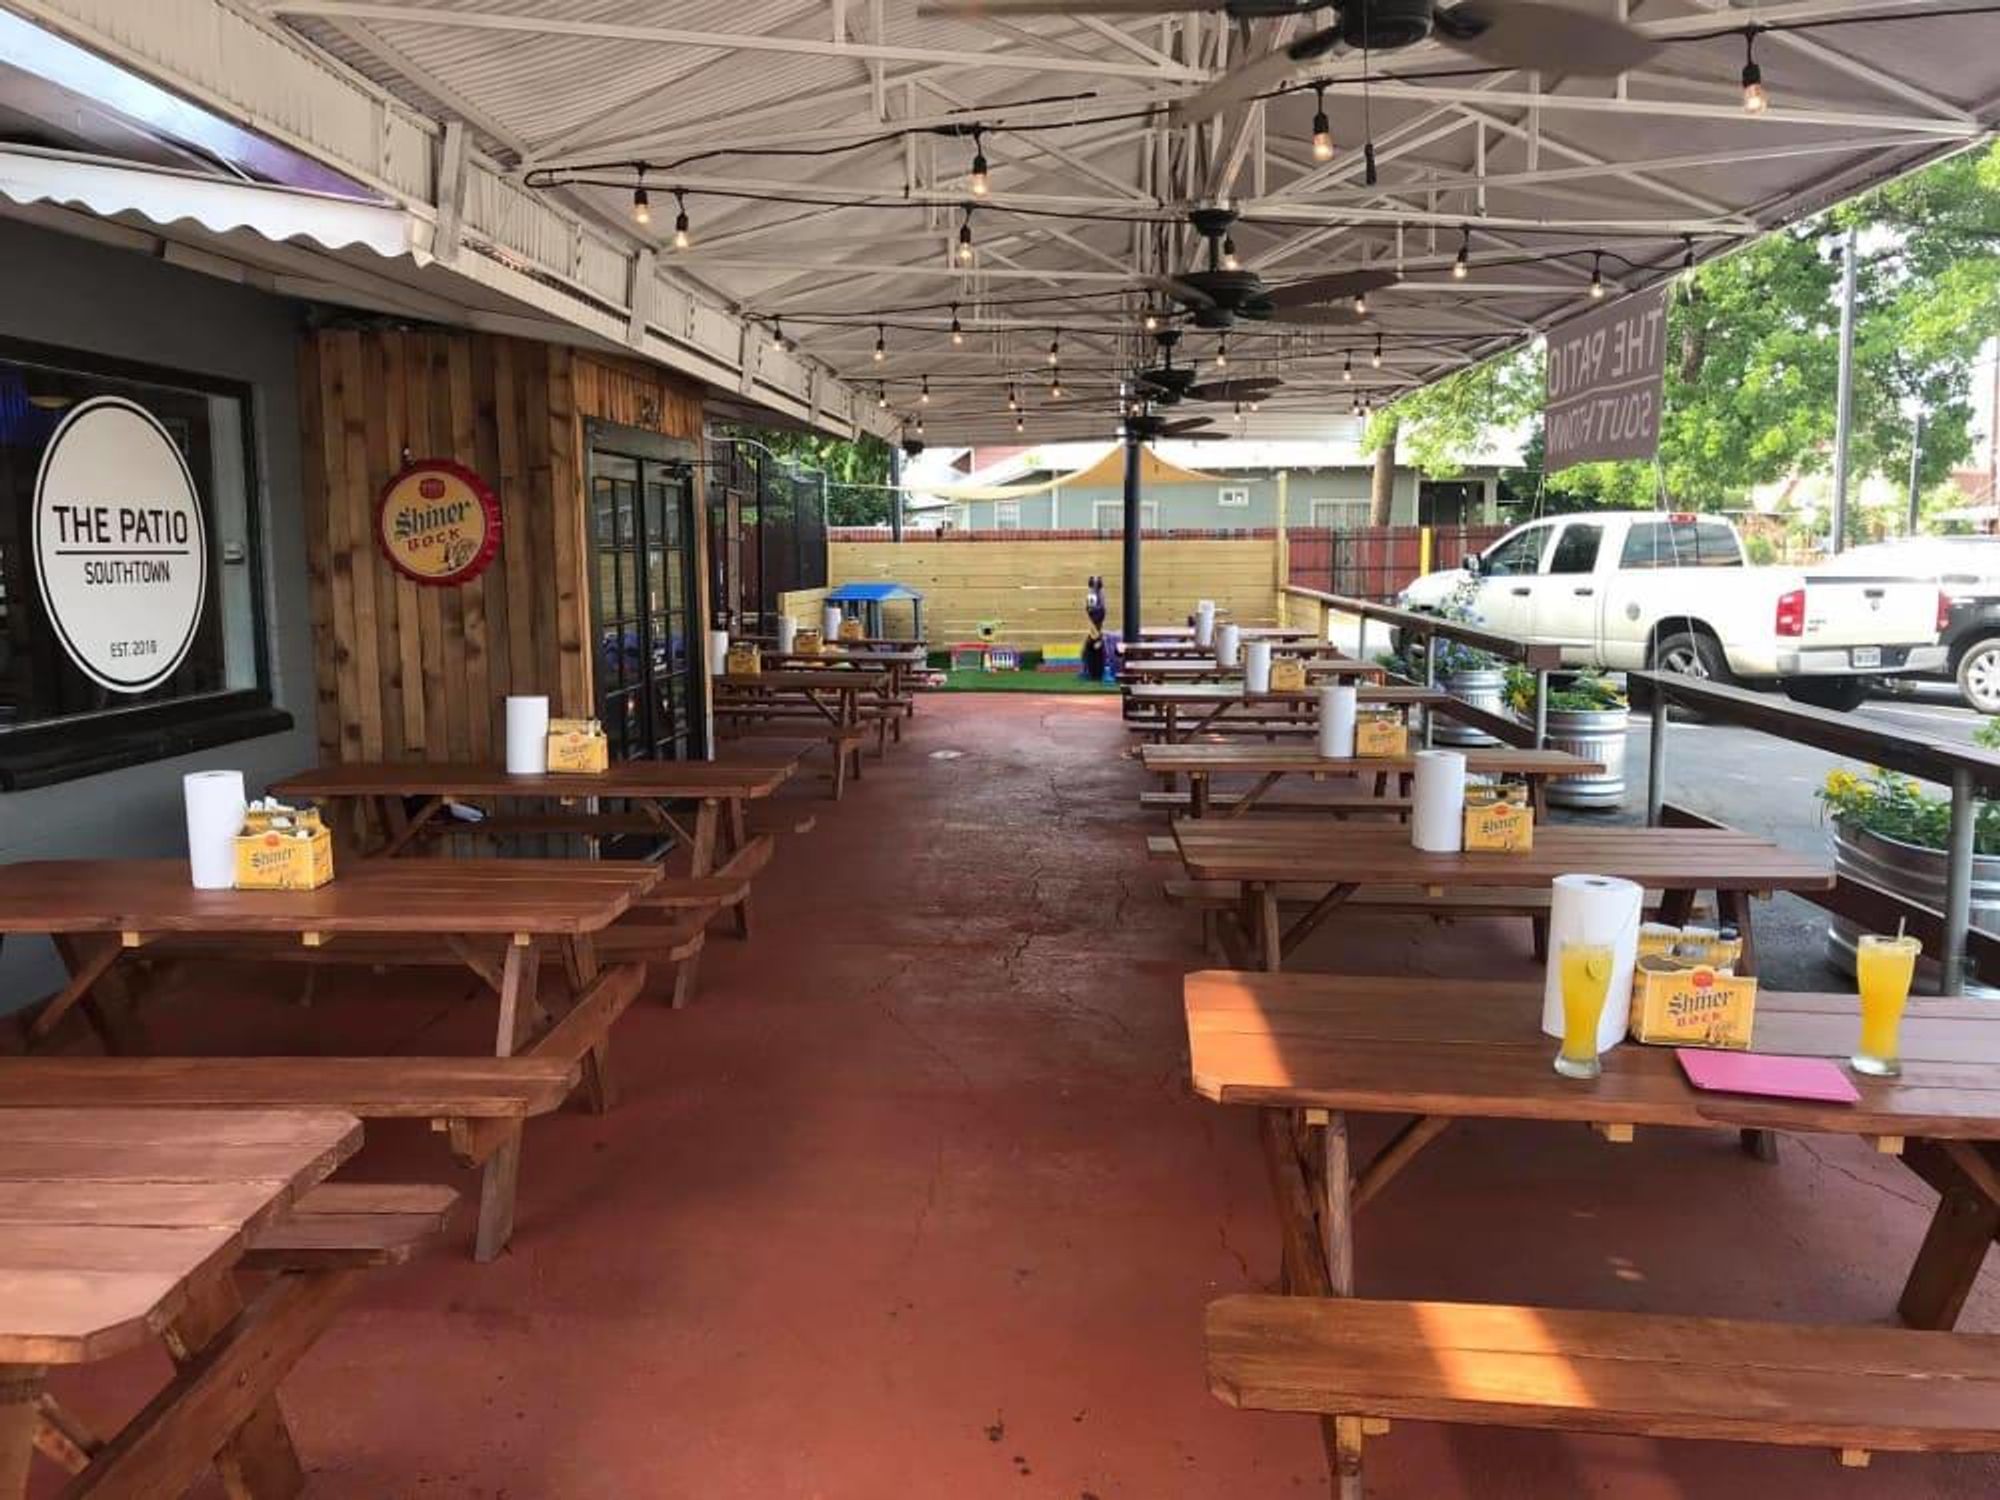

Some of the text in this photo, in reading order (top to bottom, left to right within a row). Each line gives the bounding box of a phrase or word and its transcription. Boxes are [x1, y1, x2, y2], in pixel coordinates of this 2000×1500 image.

[52, 505, 188, 544] THE PATIO
[394, 501, 472, 540] Shiner
[84, 560, 170, 585] SOUTHTOWN
[1667, 991, 1735, 1015] Shiner
